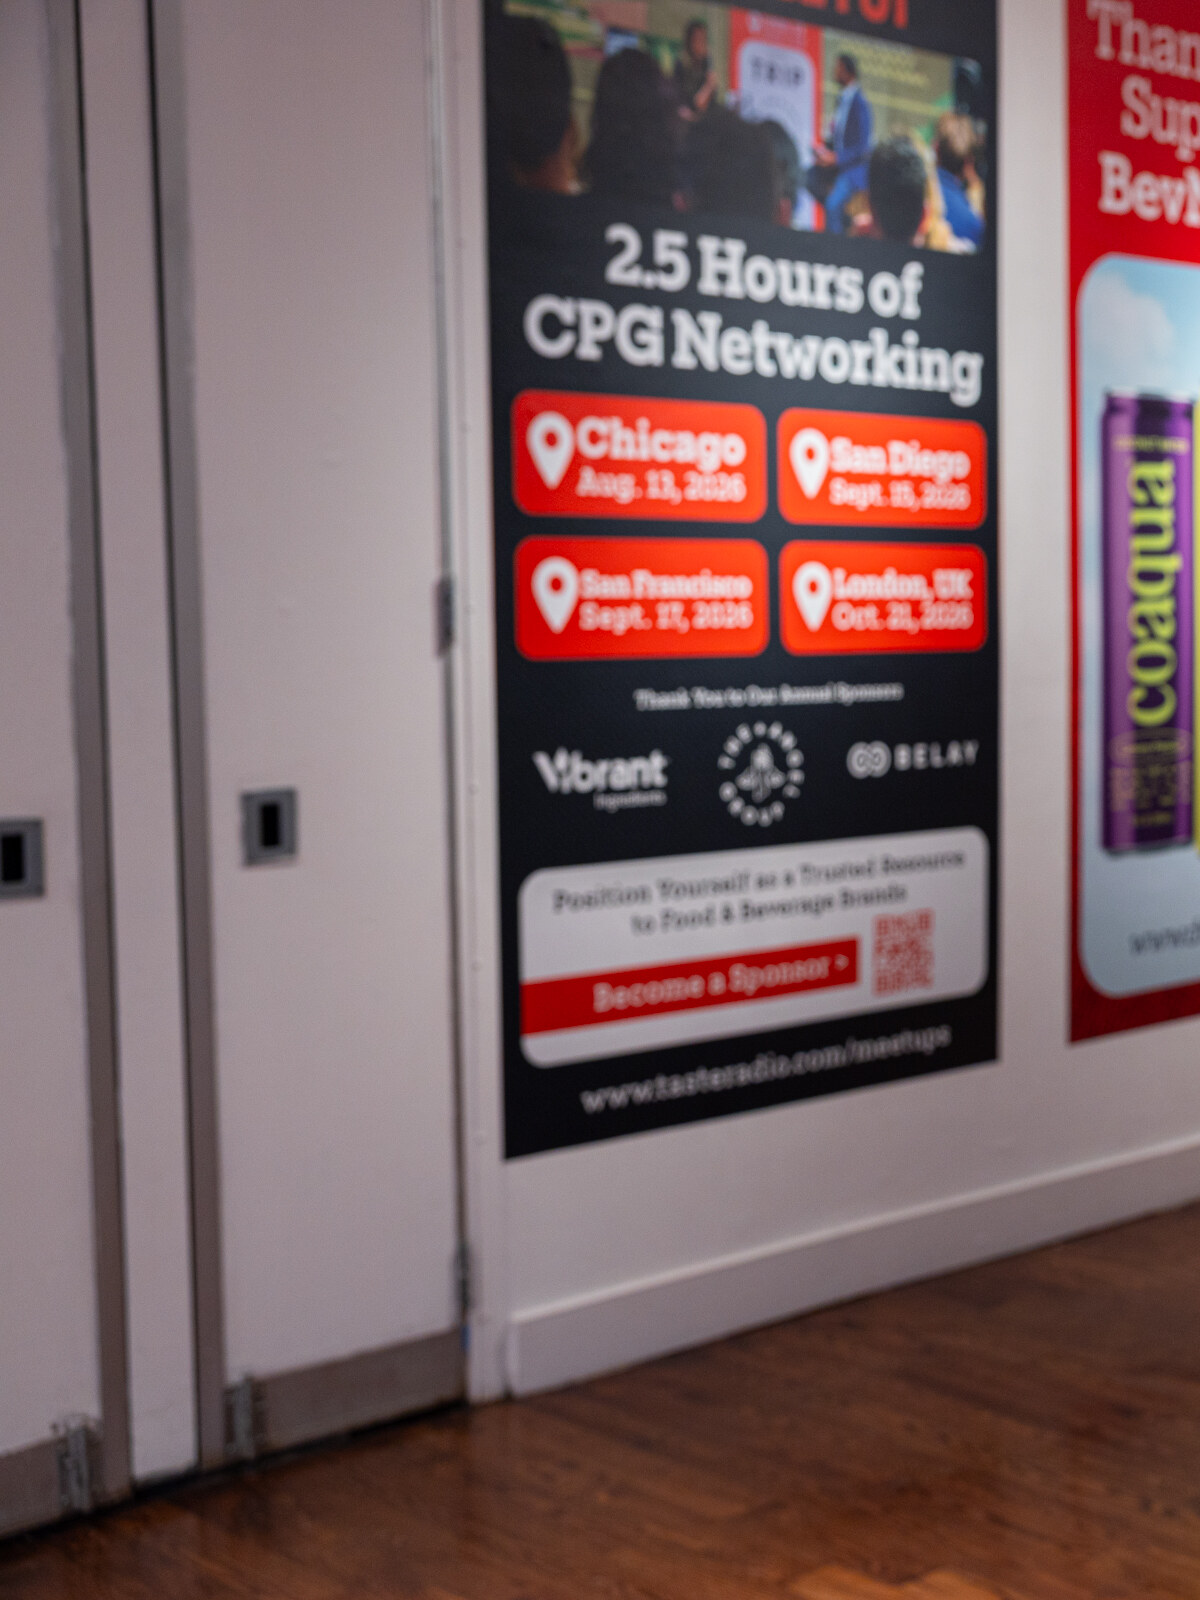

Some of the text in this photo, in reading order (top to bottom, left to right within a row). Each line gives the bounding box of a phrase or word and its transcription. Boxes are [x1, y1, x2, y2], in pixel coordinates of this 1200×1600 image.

[604, 222, 924, 320] 2.5 Hours of
[523, 294, 984, 408] CPG Networking
[575, 415, 747, 473] Chicago
[830, 436, 971, 484] San Diego
[575, 465, 747, 505] Aug. 13, 2026
[829, 477, 889, 511] Sept.
[580, 568, 754, 599] San Francisco
[832, 567, 974, 602] London, UK
[1127, 459, 1182, 726] coaqua
[579, 601, 653, 636] Sept.
[691, 600, 754, 629] 2026
[831, 601, 886, 631] Oct.
[633, 686, 691, 711] Thank
[691, 686, 725, 709] You
[532, 747, 669, 794] Vibrant
[894, 739, 979, 771] BELAY
[552, 852, 966, 914] Position Yourself as a Trusted Resource
[631, 912, 655, 936] to
[660, 903, 716, 933] Food
[740, 894, 834, 922] Beverage
[839, 884, 908, 908] Brands
[593, 974, 705, 1013] Become
[707, 971, 726, 996] a
[728, 956, 831, 996] Sponsor
[580, 1024, 951, 1113] www.tasteradio.com/meetups
